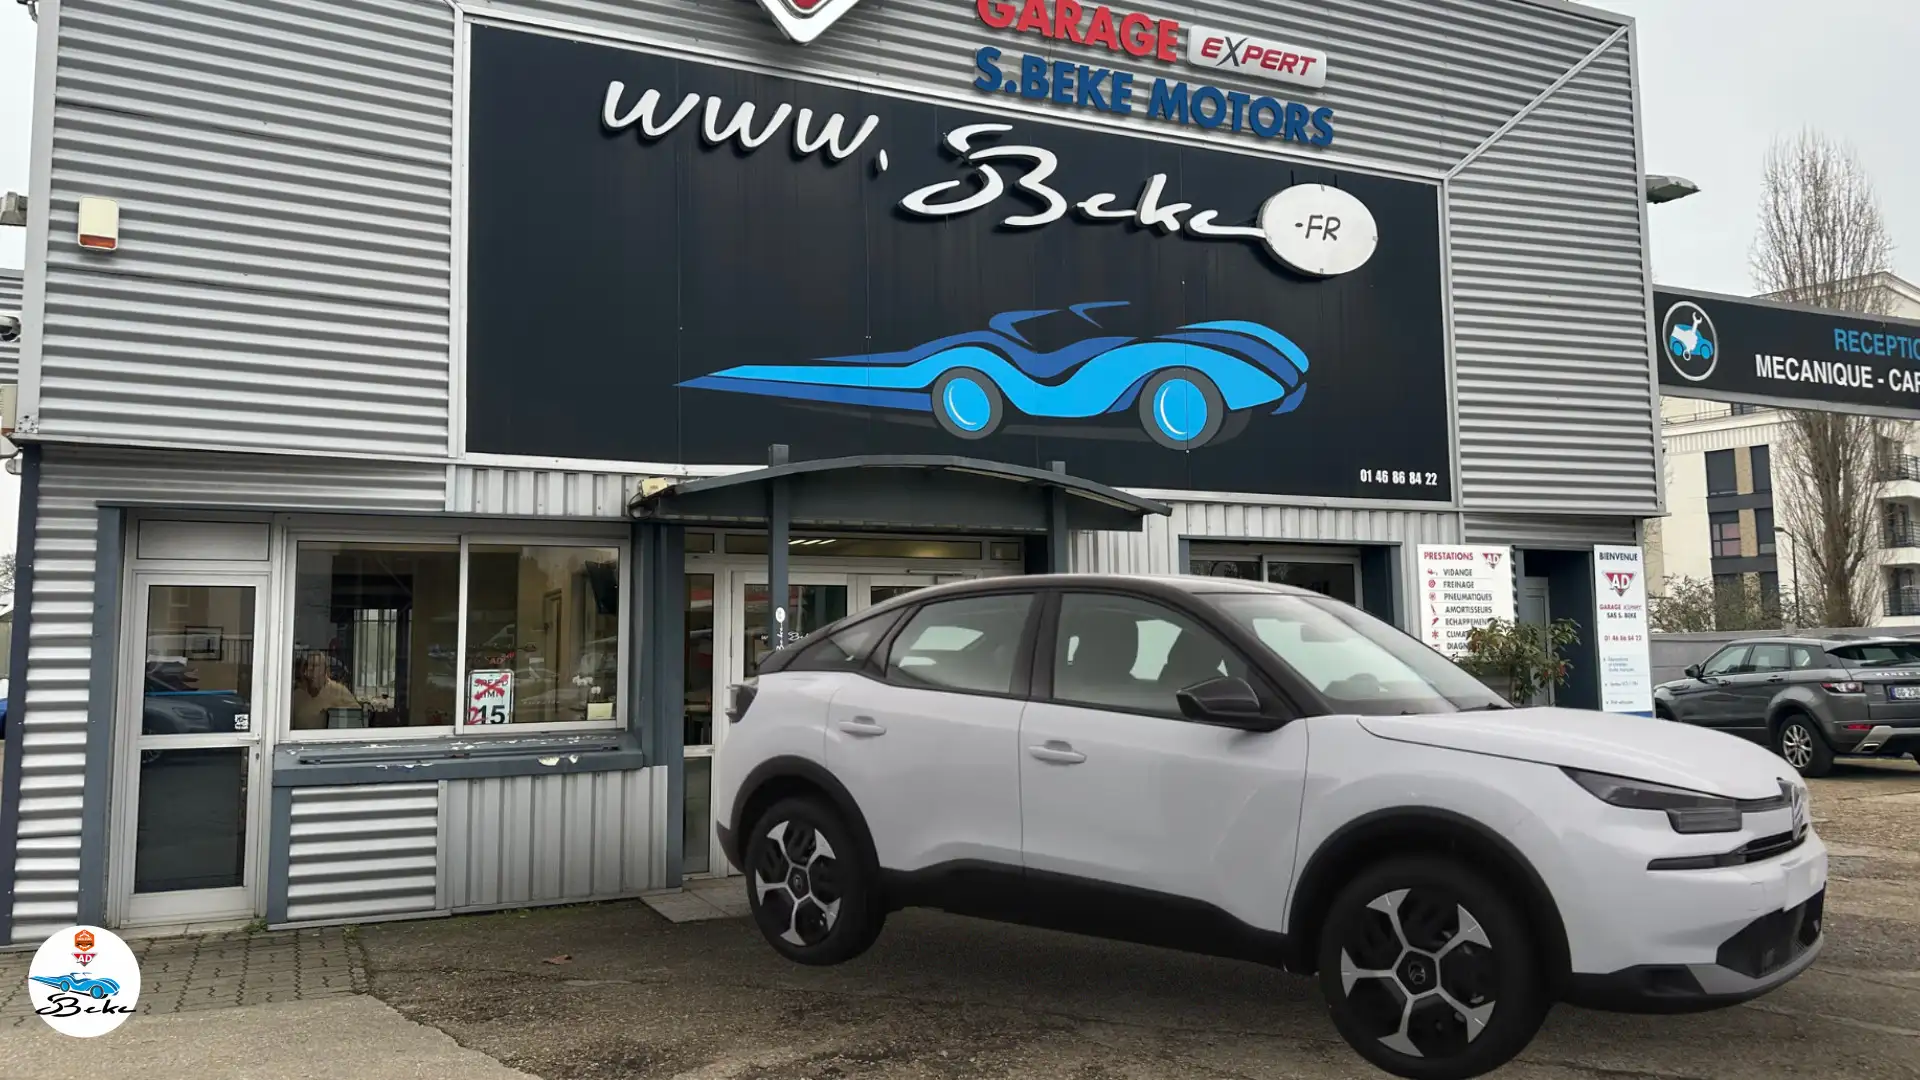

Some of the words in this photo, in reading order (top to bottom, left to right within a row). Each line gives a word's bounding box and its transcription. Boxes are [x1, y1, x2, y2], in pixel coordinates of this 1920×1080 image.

[976, 0, 1178, 62] GARAGE
[1200, 36, 1317, 77] EXPERT
[974, 46, 1133, 114] S.BEKE
[1147, 77, 1334, 146] MOTORS
[1755, 353, 1874, 388] MECANIQUE
[1360, 468, 1372, 482] 01
[1375, 469, 1389, 483] 46
[1392, 470, 1405, 484] 86
[1409, 471, 1421, 485] 84
[1425, 472, 1437, 485] 22
[1424, 551, 1473, 560] PRESTATIONS
[1599, 552, 1638, 561] BIENVENUE
[1443, 568, 1472, 576] VIDANGE
[1443, 580, 1474, 588] FREINAGE
[1611, 573, 1630, 590] AD
[1444, 593, 1492, 601] PNEUMATIQUES
